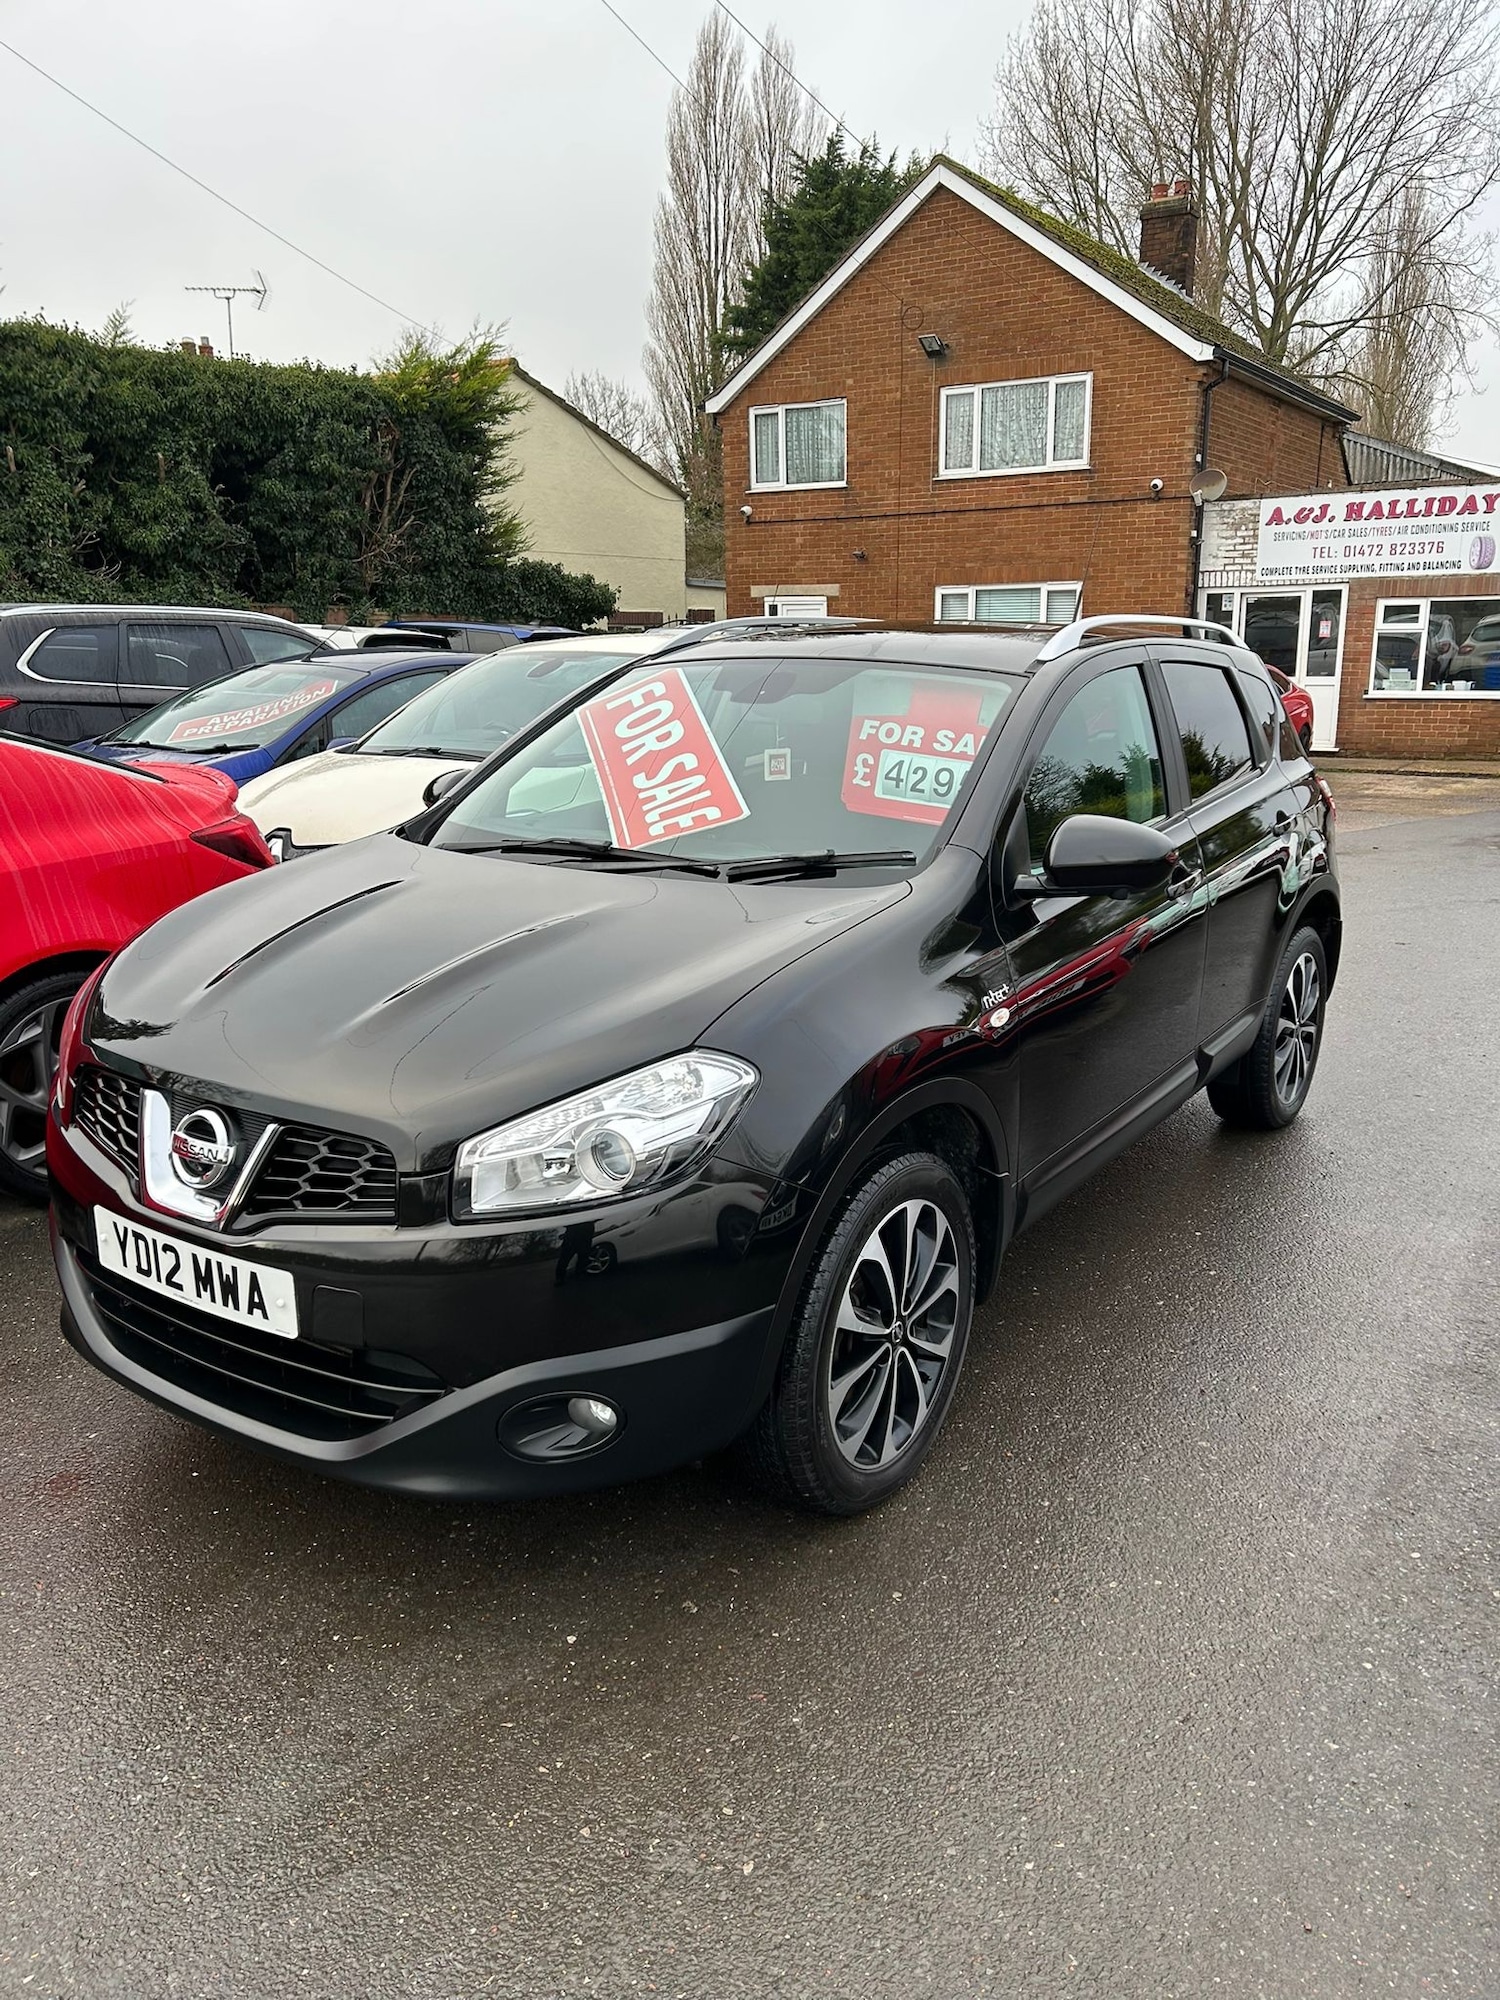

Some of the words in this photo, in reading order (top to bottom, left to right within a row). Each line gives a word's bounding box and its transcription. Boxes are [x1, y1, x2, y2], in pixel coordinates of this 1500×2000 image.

[1343, 493, 1500, 522] HALLIDAY
[1410, 522, 1459, 535] CONDITIONING
[1461, 521, 1491, 533] SERVICE
[1312, 546, 1338, 559] TEL:
[1343, 543, 1384, 558] 01472
[1389, 541, 1445, 556] 823376
[1260, 566, 1293, 577] COMPLETE
[1294, 565, 1310, 576] TYRE
[1311, 564, 1338, 575] SERVICE
[1339, 563, 1377, 574] SUPPLYING,
[1378, 562, 1405, 573] FITTING
[1406, 561, 1421, 571] AND
[1422, 560, 1462, 571] BALANCING
[183, 686, 326, 737] PREPARATION
[207, 691, 305, 726] AWAITING
[606, 681, 685, 766] FOR
[858, 719, 925, 748] FOR
[632, 752, 722, 836] SALE
[112, 1220, 184, 1292] YD12
[191, 1252, 270, 1321] MWA
